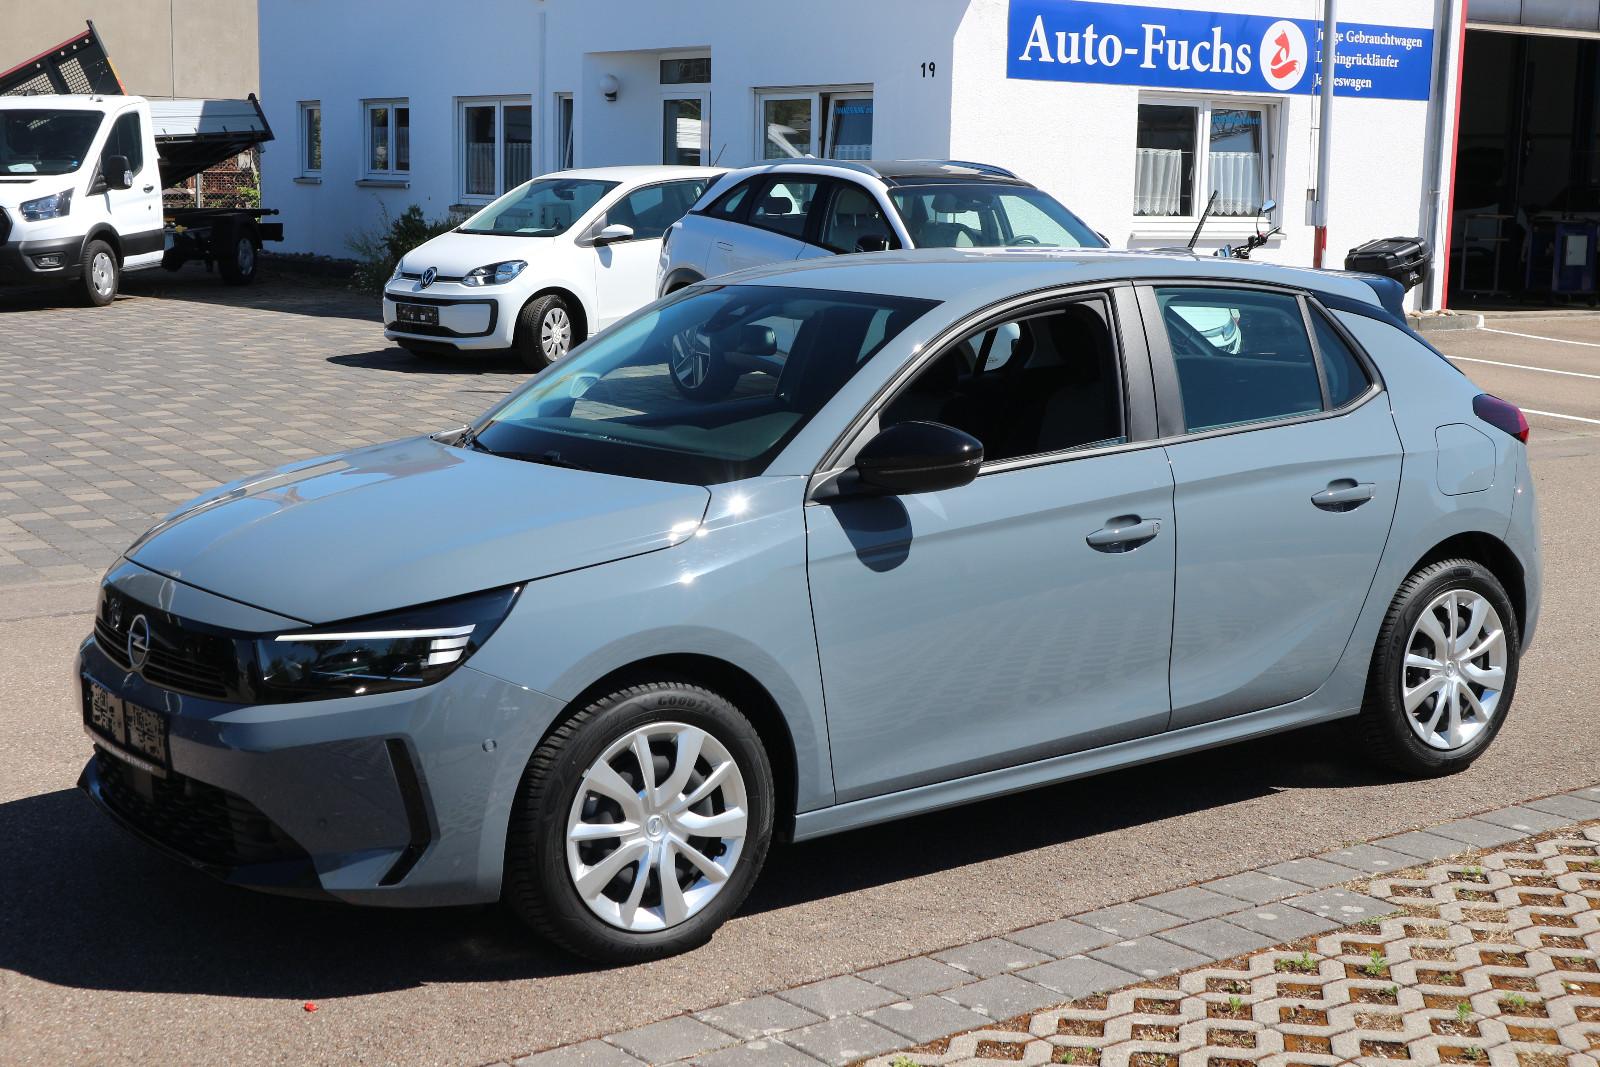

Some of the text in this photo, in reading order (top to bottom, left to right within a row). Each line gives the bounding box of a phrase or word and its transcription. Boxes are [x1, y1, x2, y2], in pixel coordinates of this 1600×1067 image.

[1018, 14, 1252, 75] Auto-Fuchs
[1346, 30, 1423, 50] Gebrauchtwagen
[1314, 50, 1400, 68] Lsingrückläufer
[920, 61, 936, 78] 19
